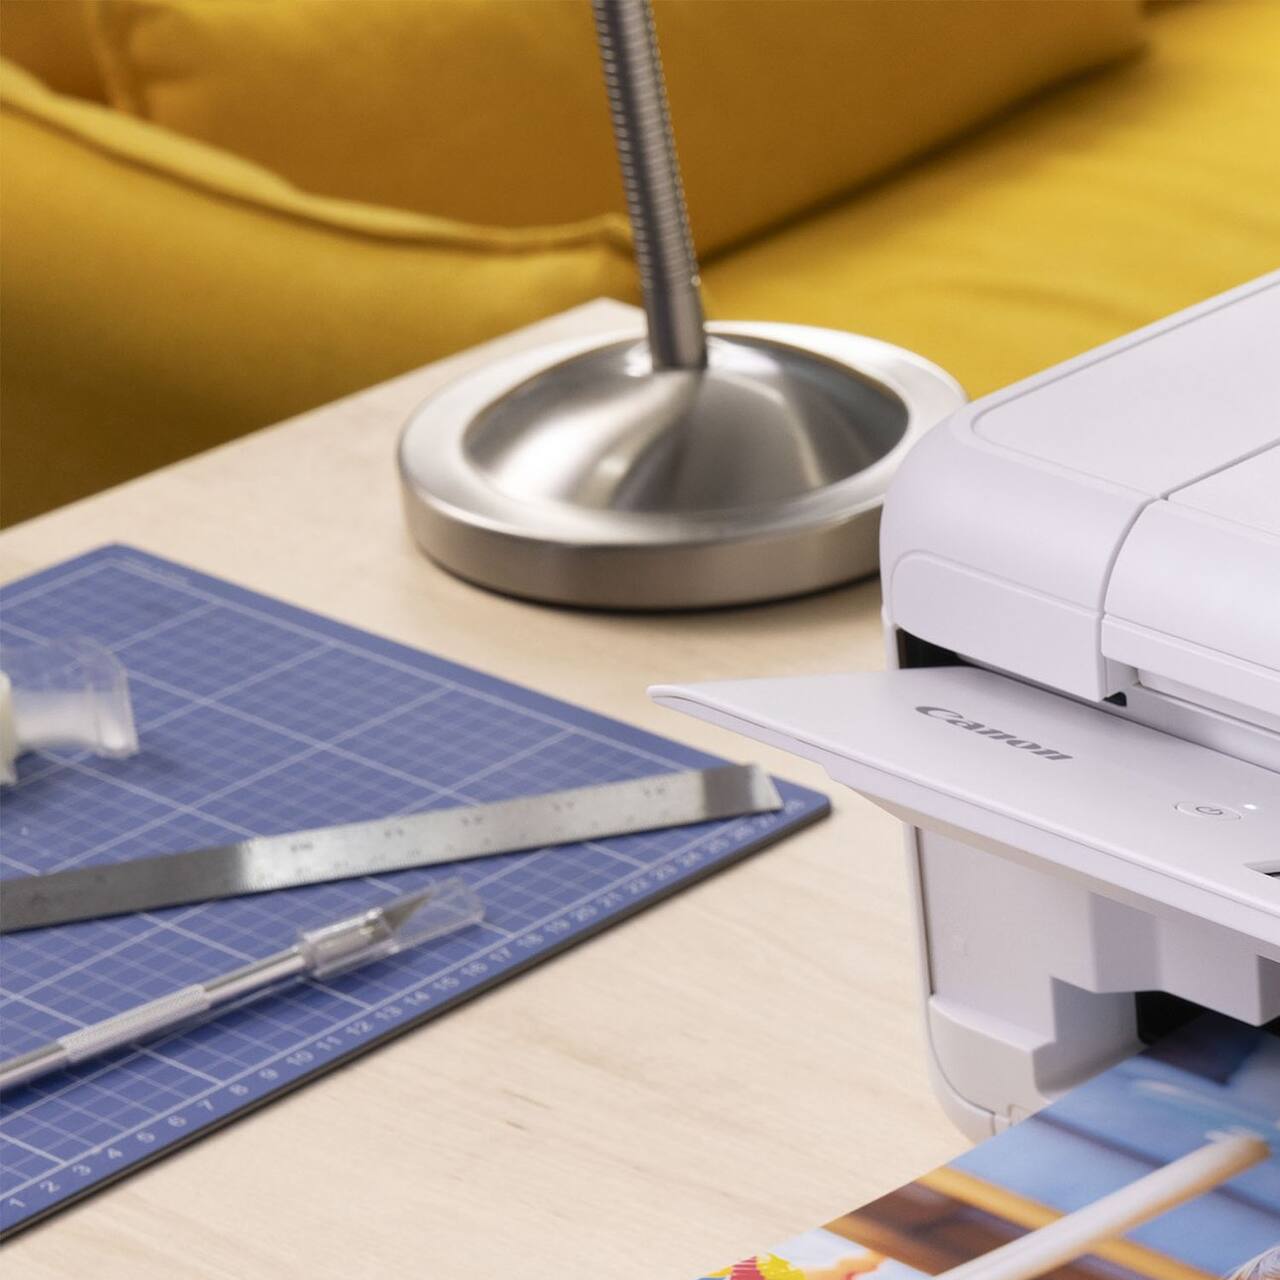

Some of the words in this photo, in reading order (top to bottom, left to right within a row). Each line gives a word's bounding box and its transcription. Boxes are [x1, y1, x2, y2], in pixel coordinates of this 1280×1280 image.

[915, 705, 1074, 761] Canon
[9, 1197, 26, 1208] 1
[40, 1181, 61, 1193] 2
[72, 1164, 91, 1176] 3
[107, 1148, 123, 1160] 4
[136, 1131, 155, 1144] 5
[168, 1115, 187, 1127] 6
[197, 1099, 214, 1111] 7
[229, 1083, 248, 1096] 8
[259, 1068, 279, 1080] 9
[286, 1050, 315, 1066] 10
[315, 1036, 343, 1050] 11
[345, 1020, 373, 1035] 12
[374, 1004, 403, 1021] 13
[403, 990, 430, 1006] 14
[432, 976, 460, 990] 15
[461, 961, 488, 977] 16
[488, 947, 512, 962] 17
[516, 933, 545, 948] 18
[543, 918, 571, 935] 19
[569, 904, 598, 921] 20
